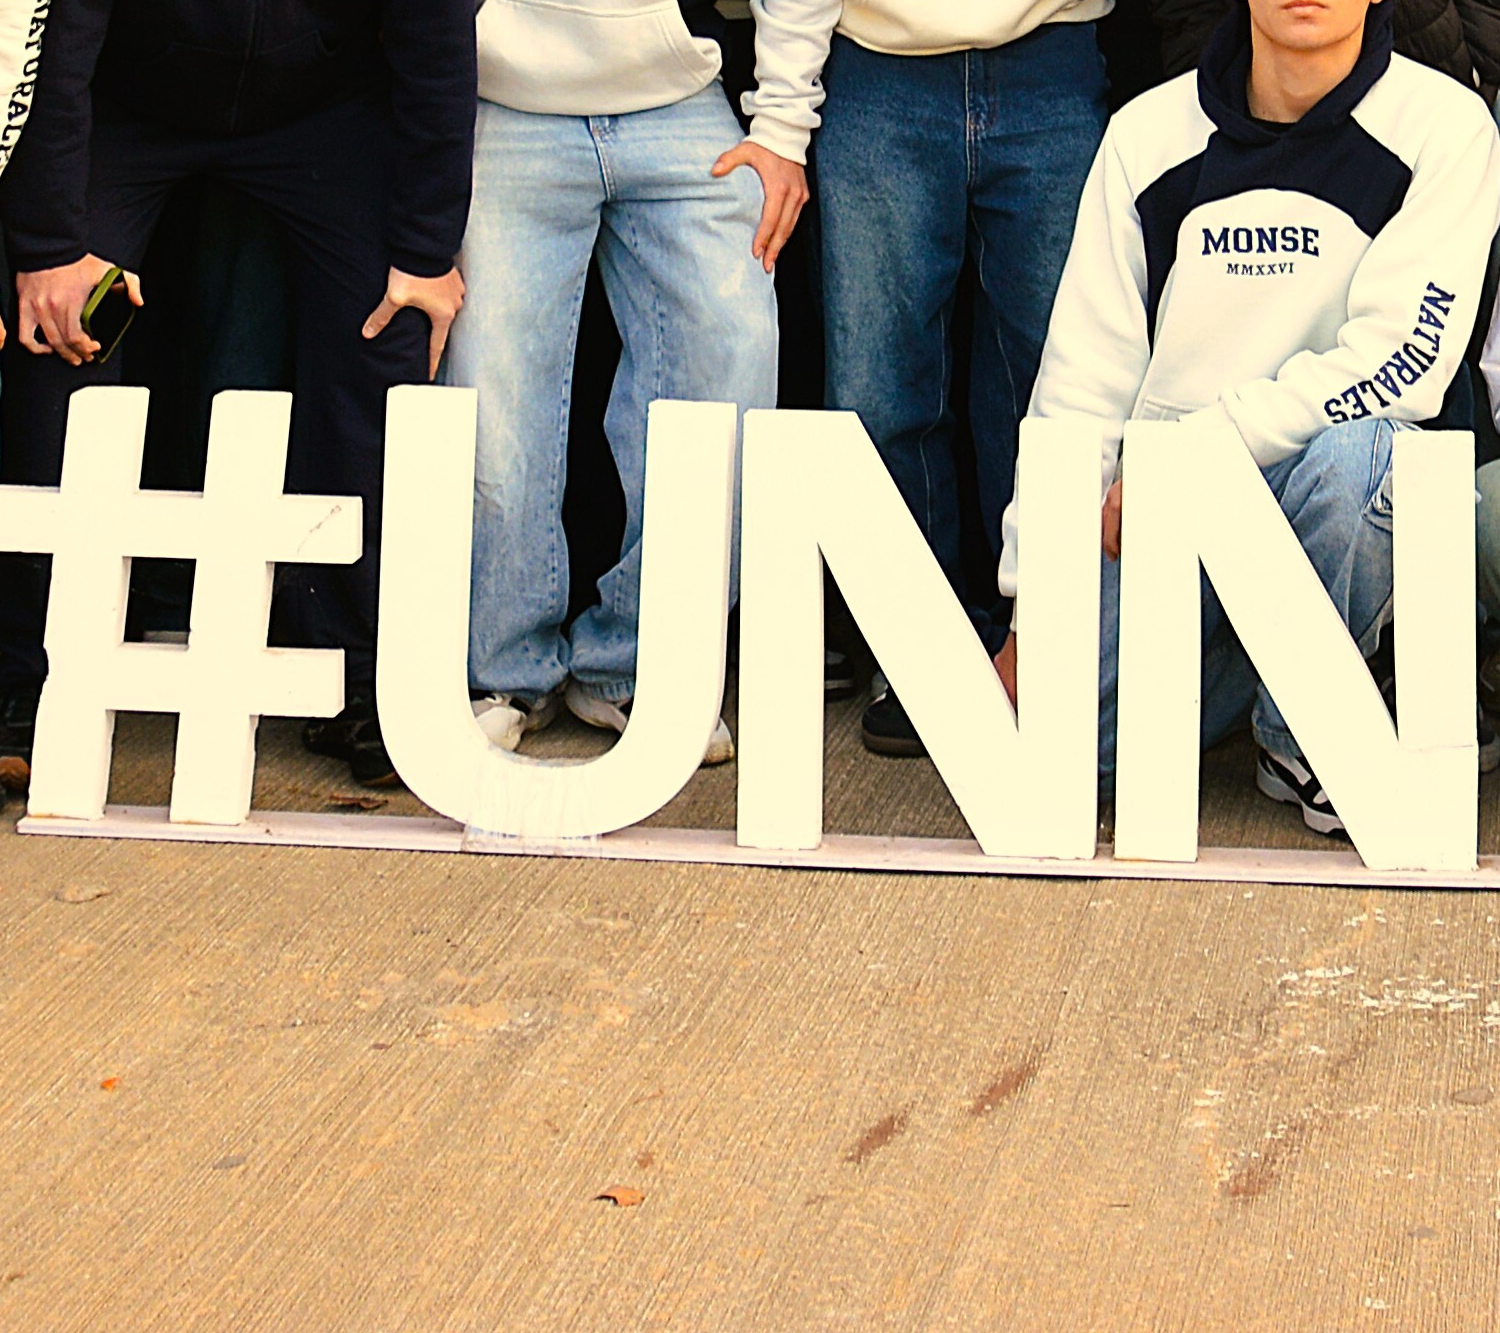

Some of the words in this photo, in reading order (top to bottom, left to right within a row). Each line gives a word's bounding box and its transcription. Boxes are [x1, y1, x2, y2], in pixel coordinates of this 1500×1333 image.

[1201, 226, 1320, 257] MONSE
[1226, 262, 1295, 276] MMXXVI
[1324, 281, 1456, 424] NATURALES
